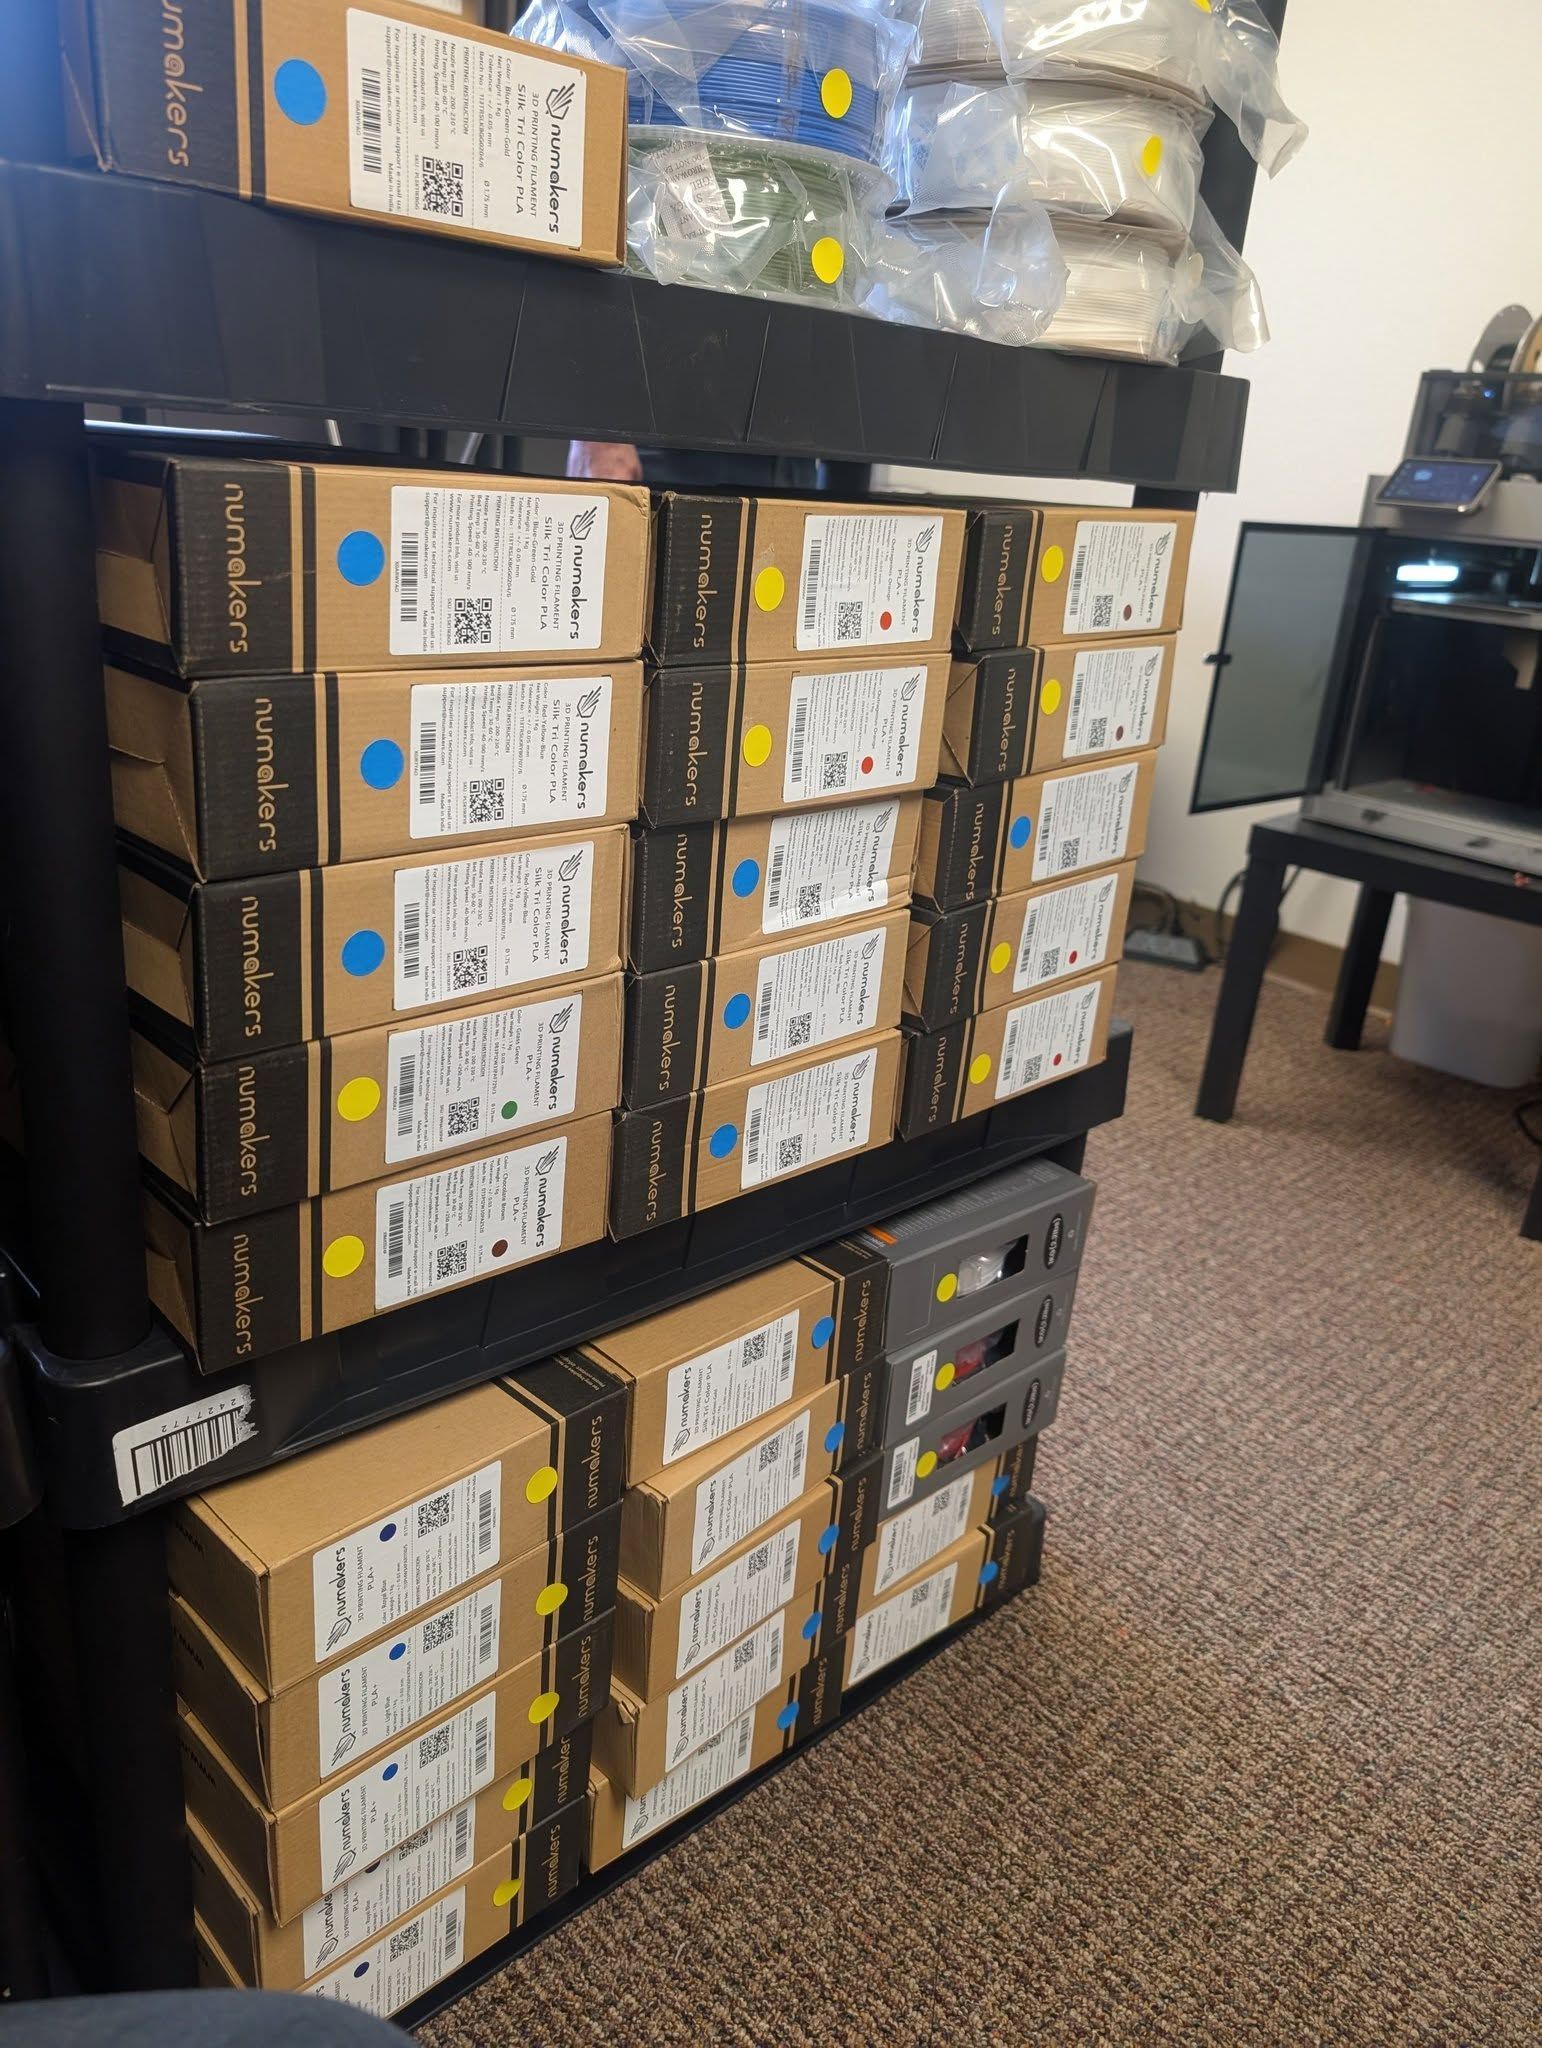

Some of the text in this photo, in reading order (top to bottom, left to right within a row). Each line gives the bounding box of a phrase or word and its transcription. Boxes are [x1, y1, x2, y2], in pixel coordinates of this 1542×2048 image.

[503, 85, 512, 157] Blue-Green-Gold
[515, 83, 526, 214] Silk Tri Color PLA
[529, 91, 539, 218] 3D PRINTING FILAMENT
[548, 123, 568, 234] numakers
[224, 484, 261, 652] numakers
[529, 520, 539, 583] Blue-Green-Gold
[539, 516, 552, 630] Silk Tri Color PLA
[551, 521, 564, 630] 3D PRINTING FILAMENT
[568, 544, 589, 639] numakers
[694, 515, 717, 647] numakers
[900, 538, 912, 625] 3D PRINTING FILAMENT
[992, 525, 1014, 637] numakers
[910, 555, 927, 633] numakers
[539, 703, 547, 759] Red-Yellow-Blue
[548, 699, 560, 803] Silk Tri Color PLA
[560, 702, 571, 802] 3D PRINTING FILAMENT
[686, 683, 707, 805] numakers
[894, 703, 911, 777] numakers
[998, 668, 1017, 772] numakers
[256, 698, 289, 851] numakers
[576, 722, 595, 809] numakers
[672, 834, 692, 947] numakers
[864, 834, 881, 903] numakers
[965, 803, 984, 901] numakers
[531, 866, 542, 963] Silk Tri Color PLA
[543, 868, 553, 960] 3D PRINTING FILAMENT
[558, 883, 577, 965] numakers
[242, 897, 274, 1036] numakers
[840, 980, 848, 1005] Color
[844, 948, 852, 965] Silk
[855, 960, 872, 1025] numakers
[949, 923, 969, 1016] numakers
[532, 1021, 544, 1107] 3D PRINTING FILAMENT
[547, 1035, 566, 1110] numakers
[659, 984, 682, 1091] numakers
[847, 1080, 863, 1143] numakers
[928, 1036, 948, 1124] numakers
[239, 1067, 270, 1195] numakers
[647, 1121, 666, 1221] numakers
[519, 1164, 530, 1246] 3D PRINTING FILAMENT
[534, 1175, 553, 1248] numakers
[234, 1235, 263, 1354] numakers
[853, 1279, 872, 1362] numakers
[676, 1365, 692, 1429] numakers
[701, 1362, 713, 1433] Silk Tri Color PLA
[854, 1371, 872, 1454] numakers
[581, 1414, 603, 1510] numakers
[703, 1478, 717, 1539] numakers
[849, 1475, 867, 1554] numakers
[328, 1546, 346, 1617] numakers
[356, 1578, 364, 1612] PRINTING
[357, 1611, 364, 1623] 3D
[578, 1535, 599, 1623] numakers
[688, 1587, 702, 1644] numakers
[833, 1563, 851, 1637] numakers
[333, 1667, 351, 1733] numakers
[574, 1635, 592, 1719] numakers
[676, 1684, 689, 1739] numakers
[810, 1655, 828, 1727] numakers
[552, 1734, 571, 1807] numaker
[333, 1787, 351, 1851] numakers
[543, 1823, 561, 1899] numakers
[316, 1889, 334, 1938] numake
